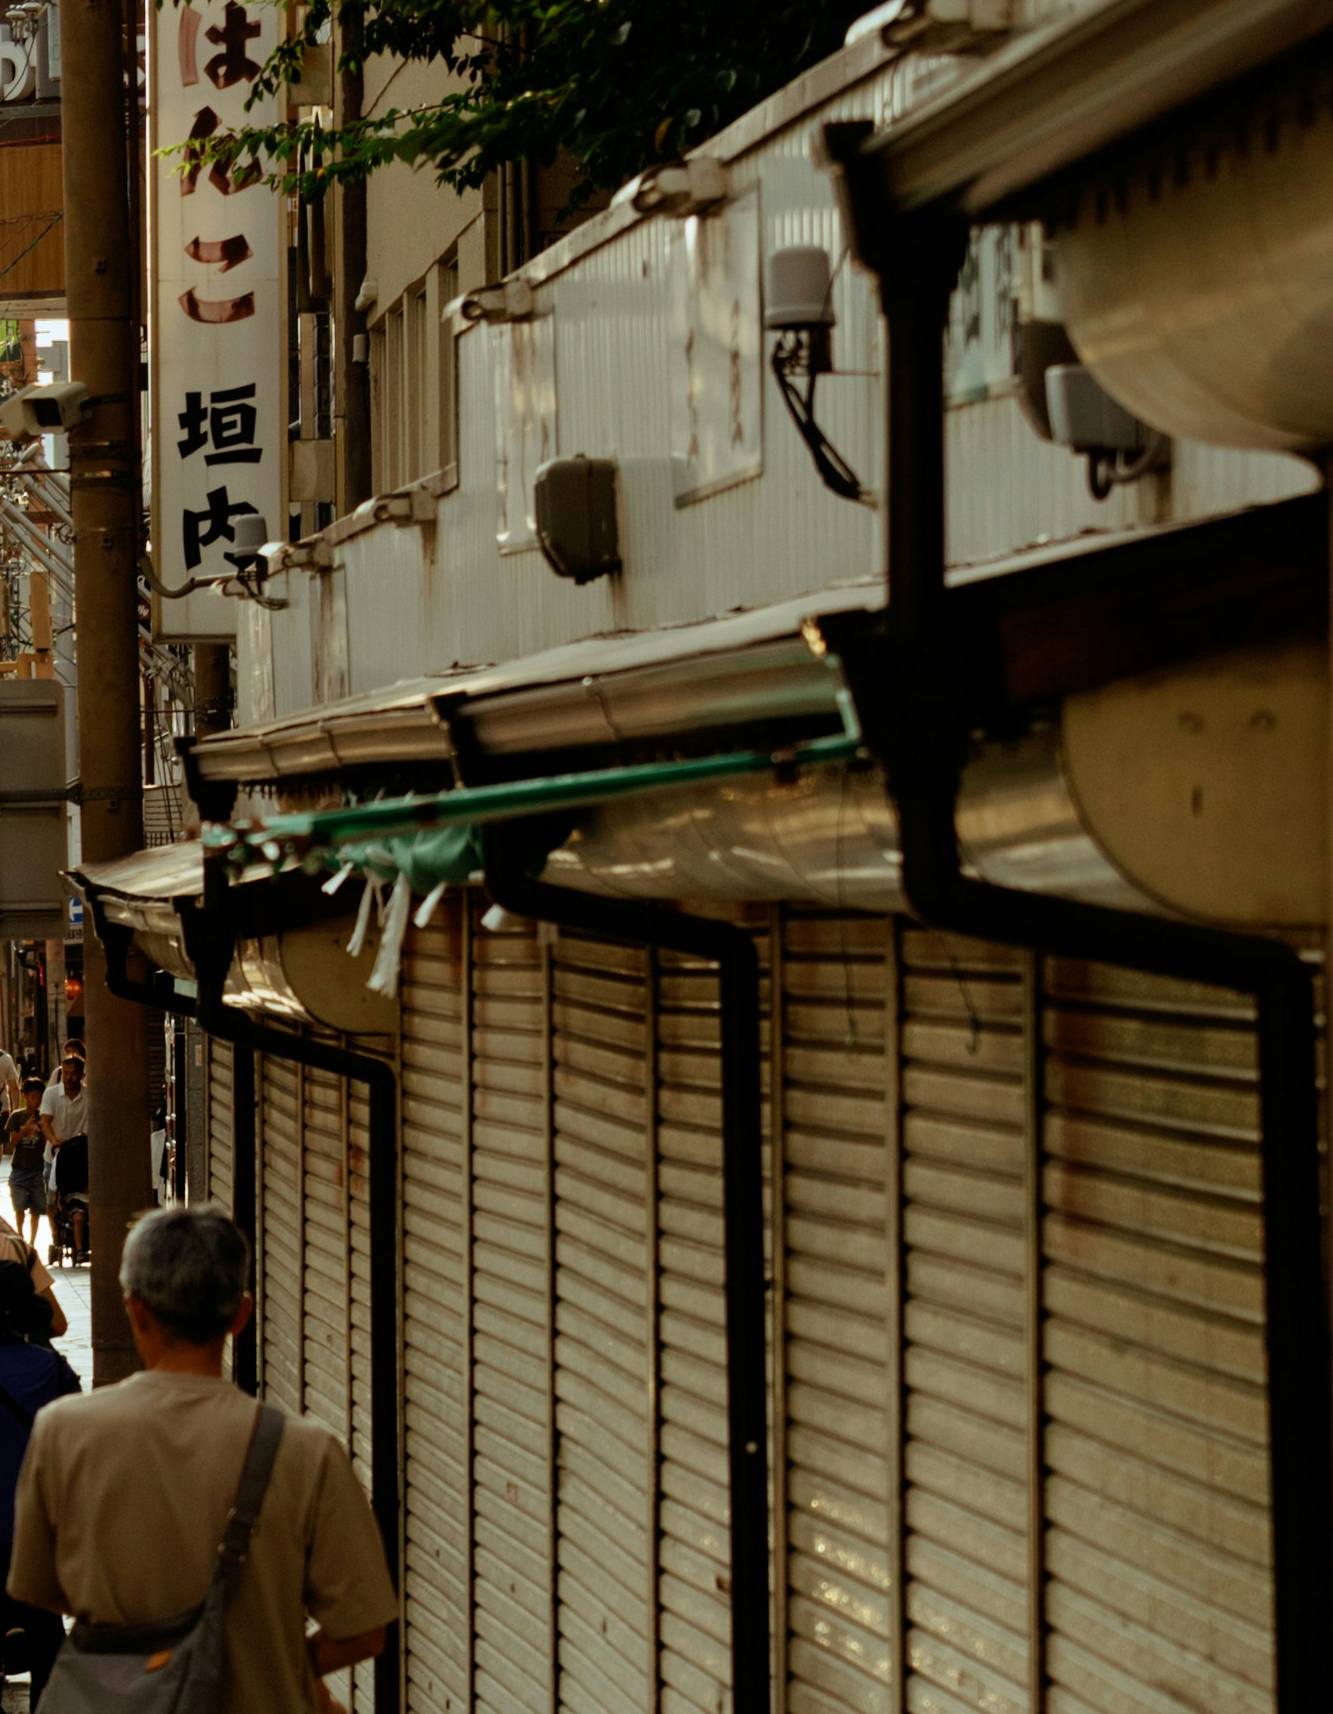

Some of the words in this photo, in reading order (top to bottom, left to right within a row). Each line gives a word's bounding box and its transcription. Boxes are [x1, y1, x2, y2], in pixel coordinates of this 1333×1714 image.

[178, 0, 264, 325] はんこ
[178, 382, 264, 573] 垣内
